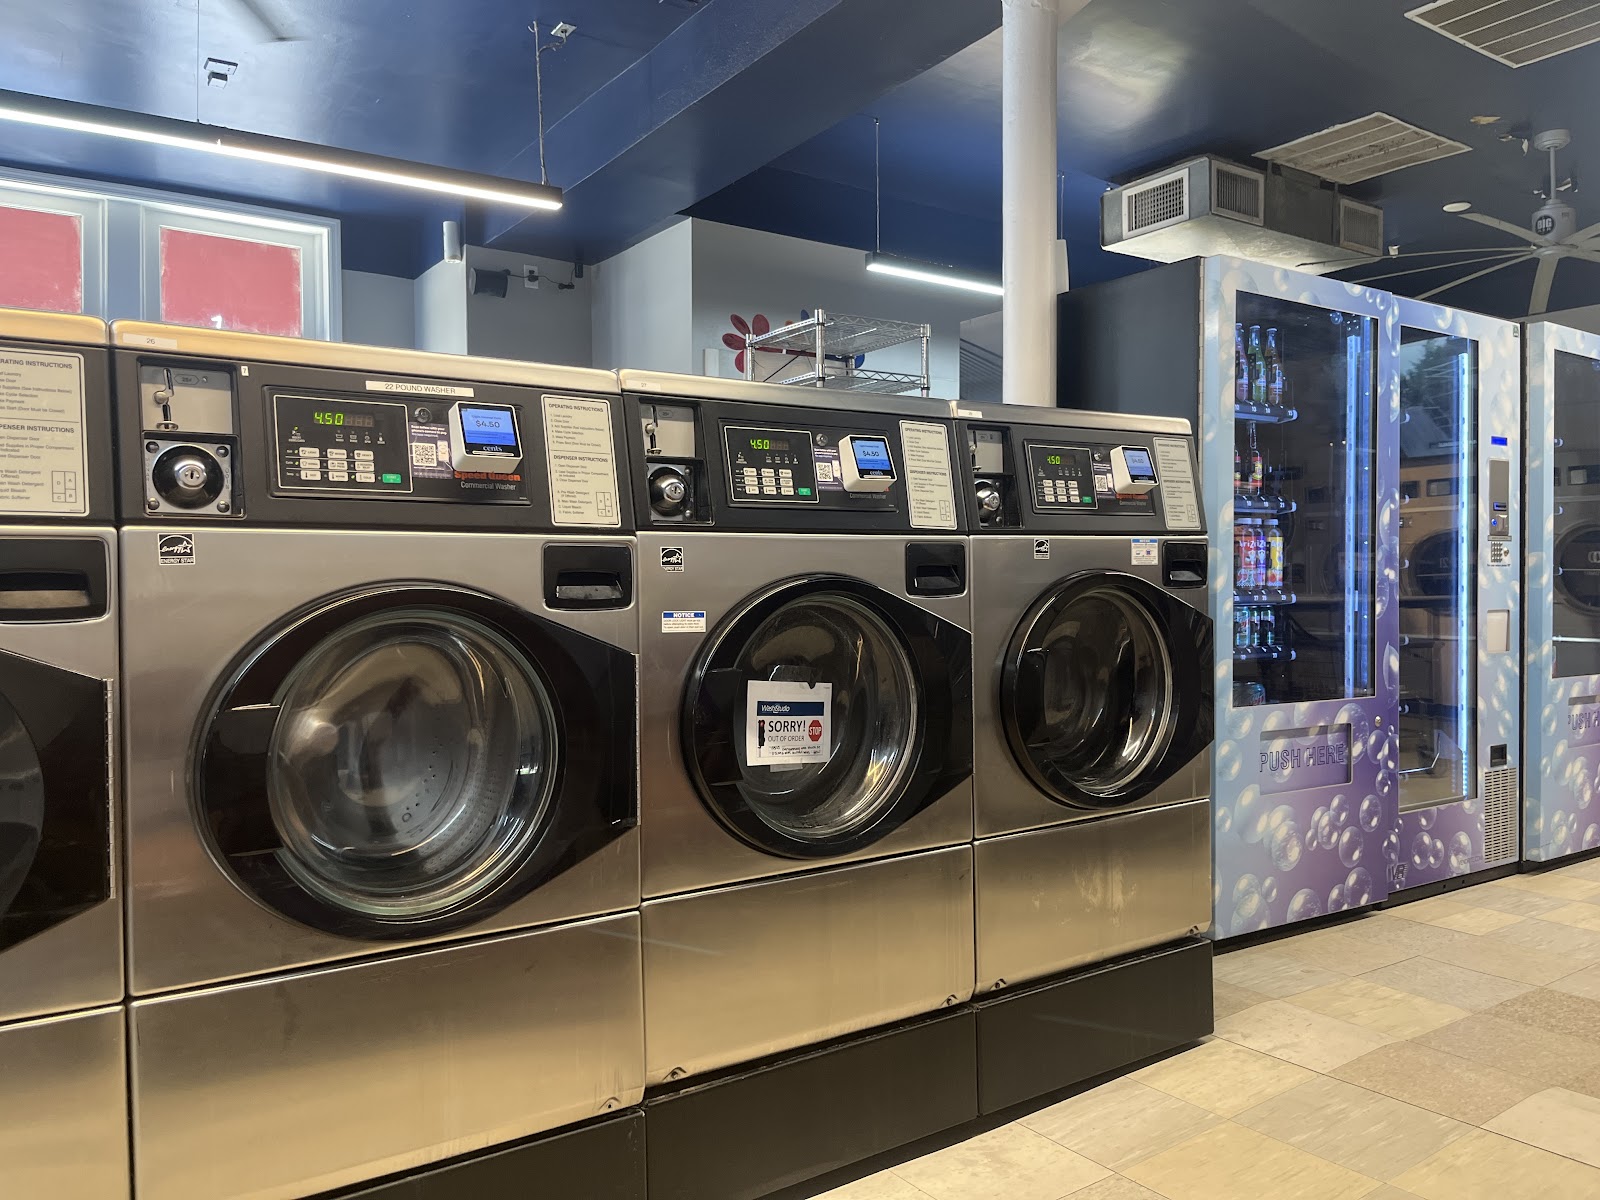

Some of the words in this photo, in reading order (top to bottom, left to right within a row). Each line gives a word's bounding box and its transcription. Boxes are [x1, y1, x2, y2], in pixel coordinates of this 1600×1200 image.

[1537, 217, 1552, 230] BIG
[25, 361, 72, 369] INSTRUCTIONS
[395, 384, 423, 392] POUND
[424, 386, 456, 394] WASHER
[314, 411, 344, 425] 4.50
[26, 425, 74, 433] INSTRUCTIONS
[476, 420, 500, 428] $4.50
[460, 481, 494, 490] Commercial
[495, 483, 516, 491] Washer
[768, 720, 806, 732] SORRY!
[809, 726, 821, 735] STOP
[1259, 748, 1301, 772] PUSH
[1306, 743, 1345, 766] HERE
